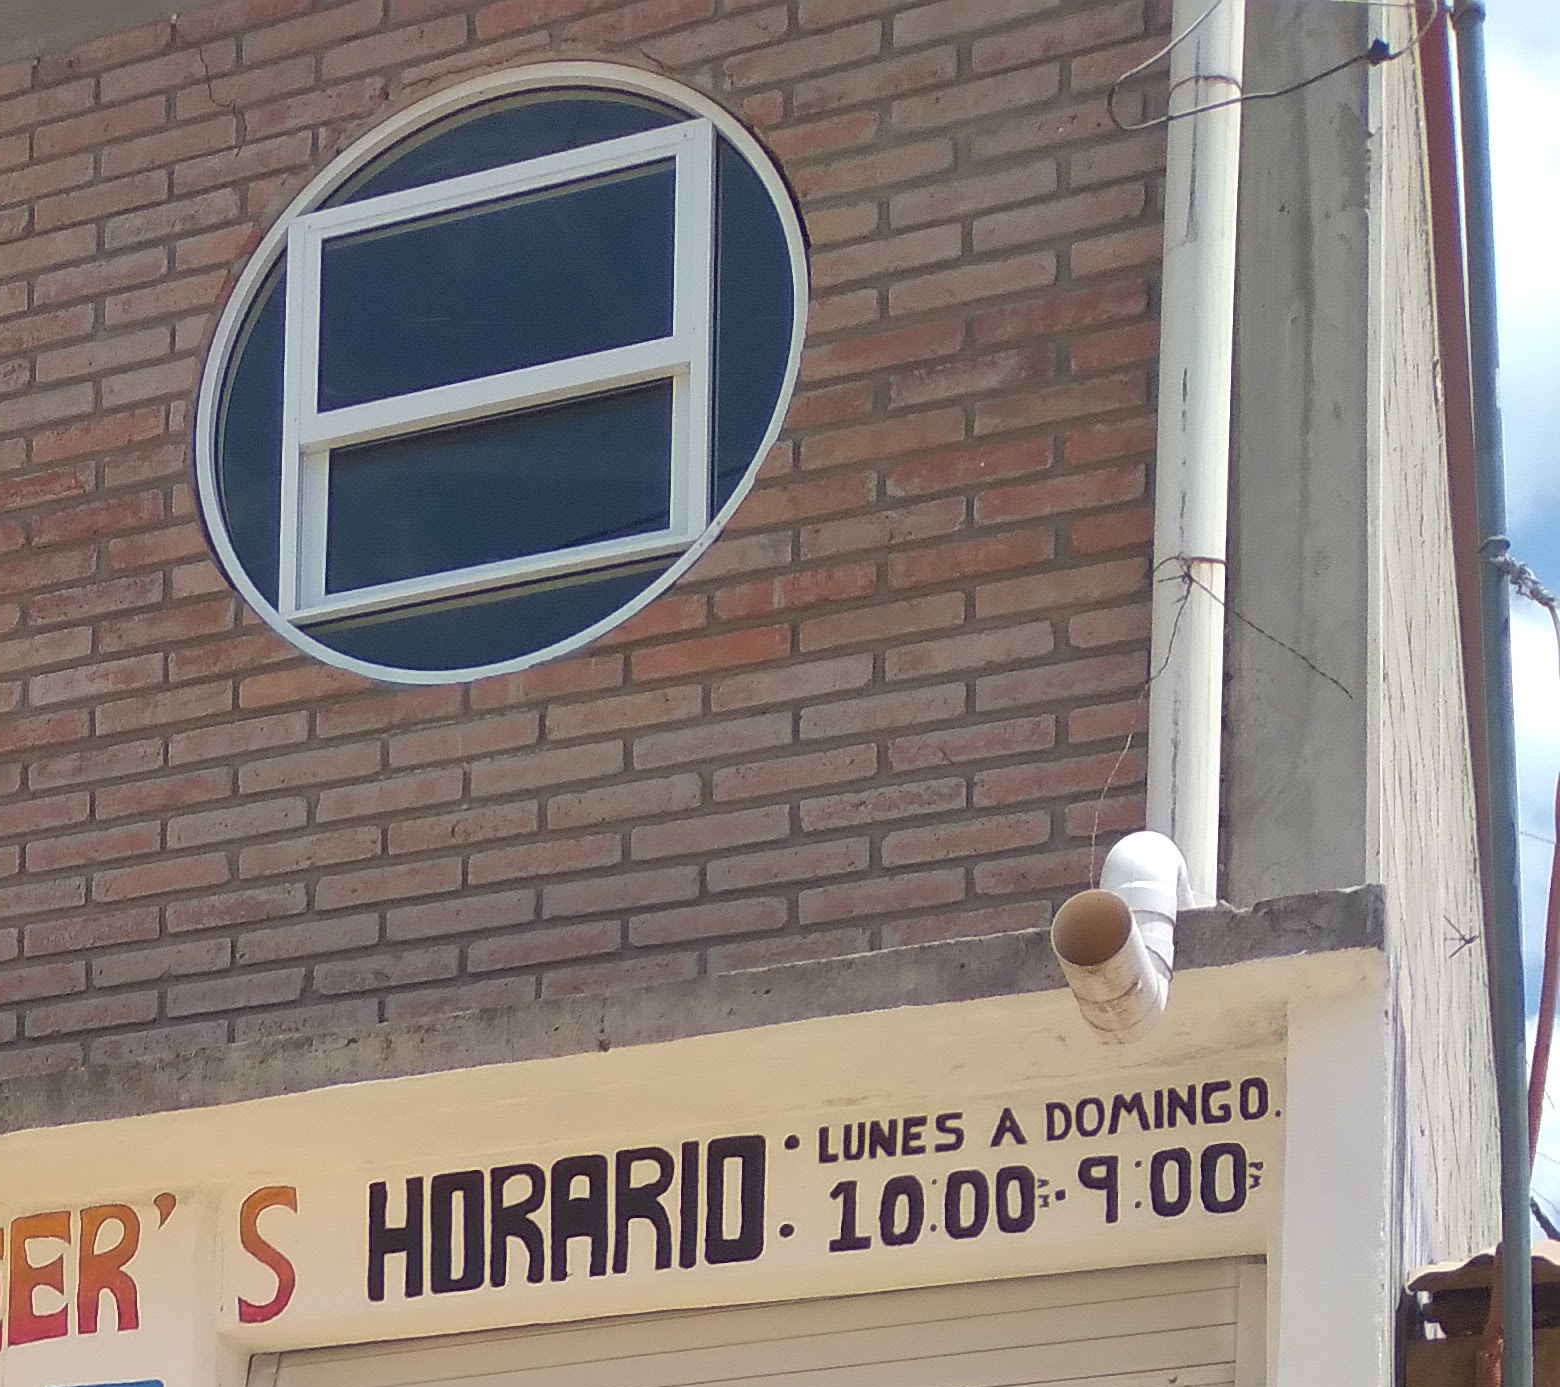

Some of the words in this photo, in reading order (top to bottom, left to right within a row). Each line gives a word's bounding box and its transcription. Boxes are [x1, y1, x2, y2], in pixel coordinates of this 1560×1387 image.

[818, 1112, 965, 1163] LUNES
[990, 1107, 1028, 1147] A
[828, 1165, 1037, 1252] 10:00
[1078, 1142, 1247, 1224] 9:00
